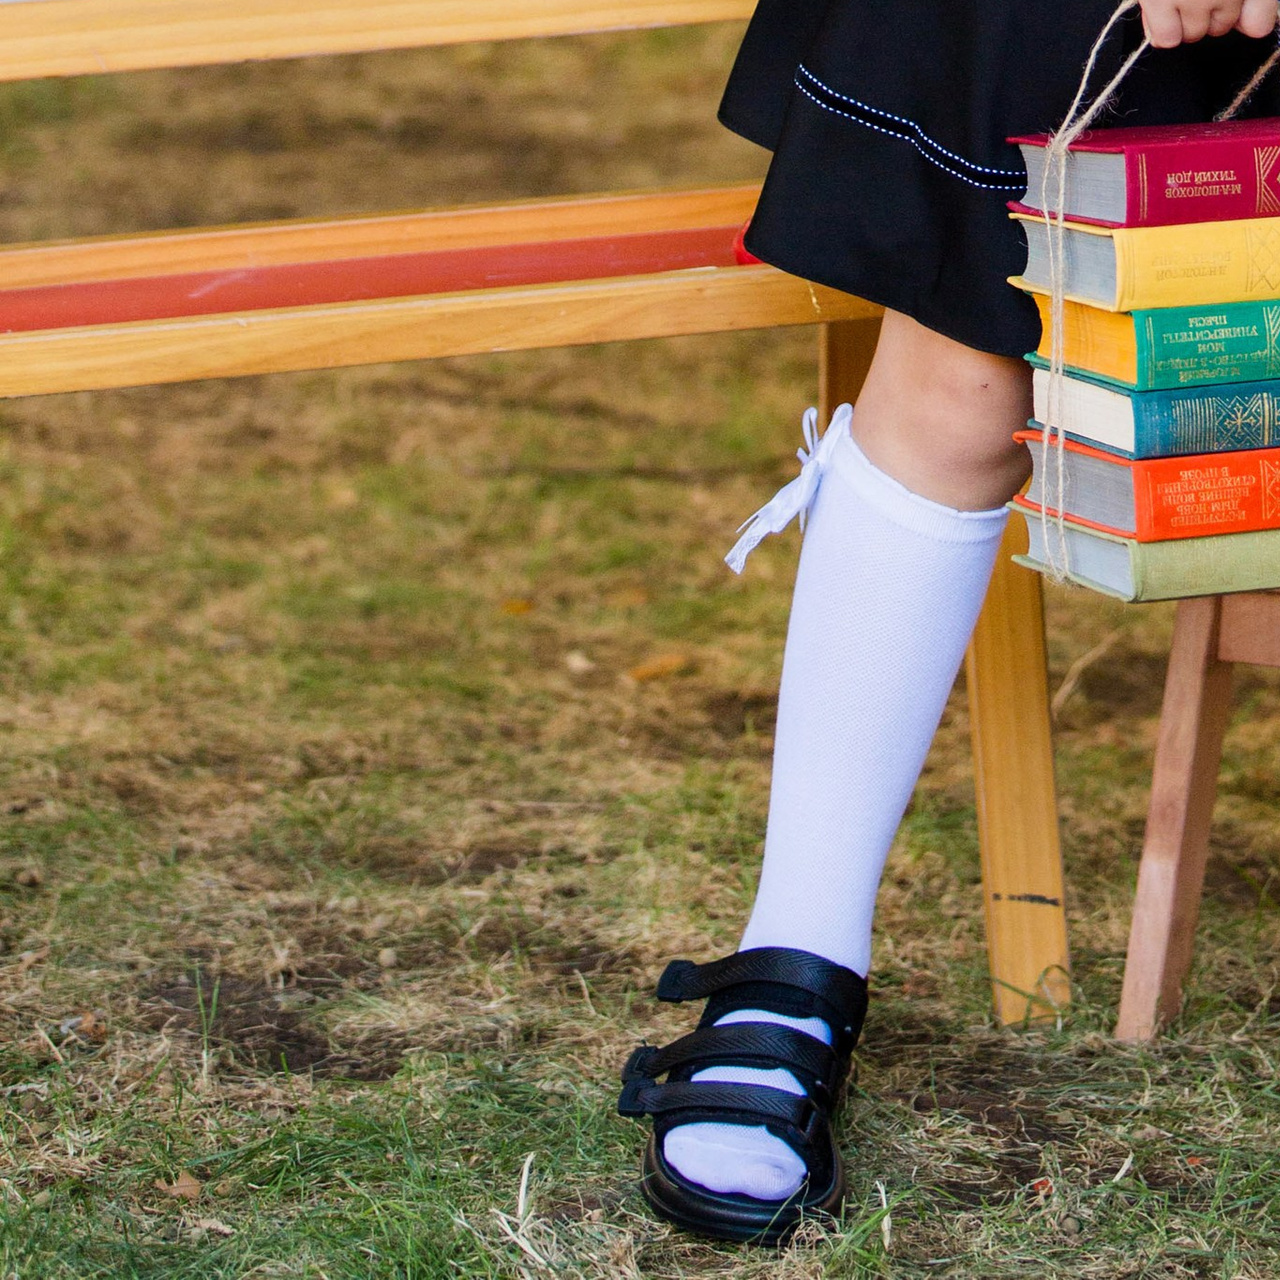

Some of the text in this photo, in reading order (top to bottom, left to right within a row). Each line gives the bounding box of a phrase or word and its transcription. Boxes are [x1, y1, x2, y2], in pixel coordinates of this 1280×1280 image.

[1166, 170, 1237, 185] ТИХИЙ ДОН
[1188, 315, 1228, 327] ПЬЕСЫ
[1162, 325, 1258, 344] УНИВЕРСИТЕТЫ
